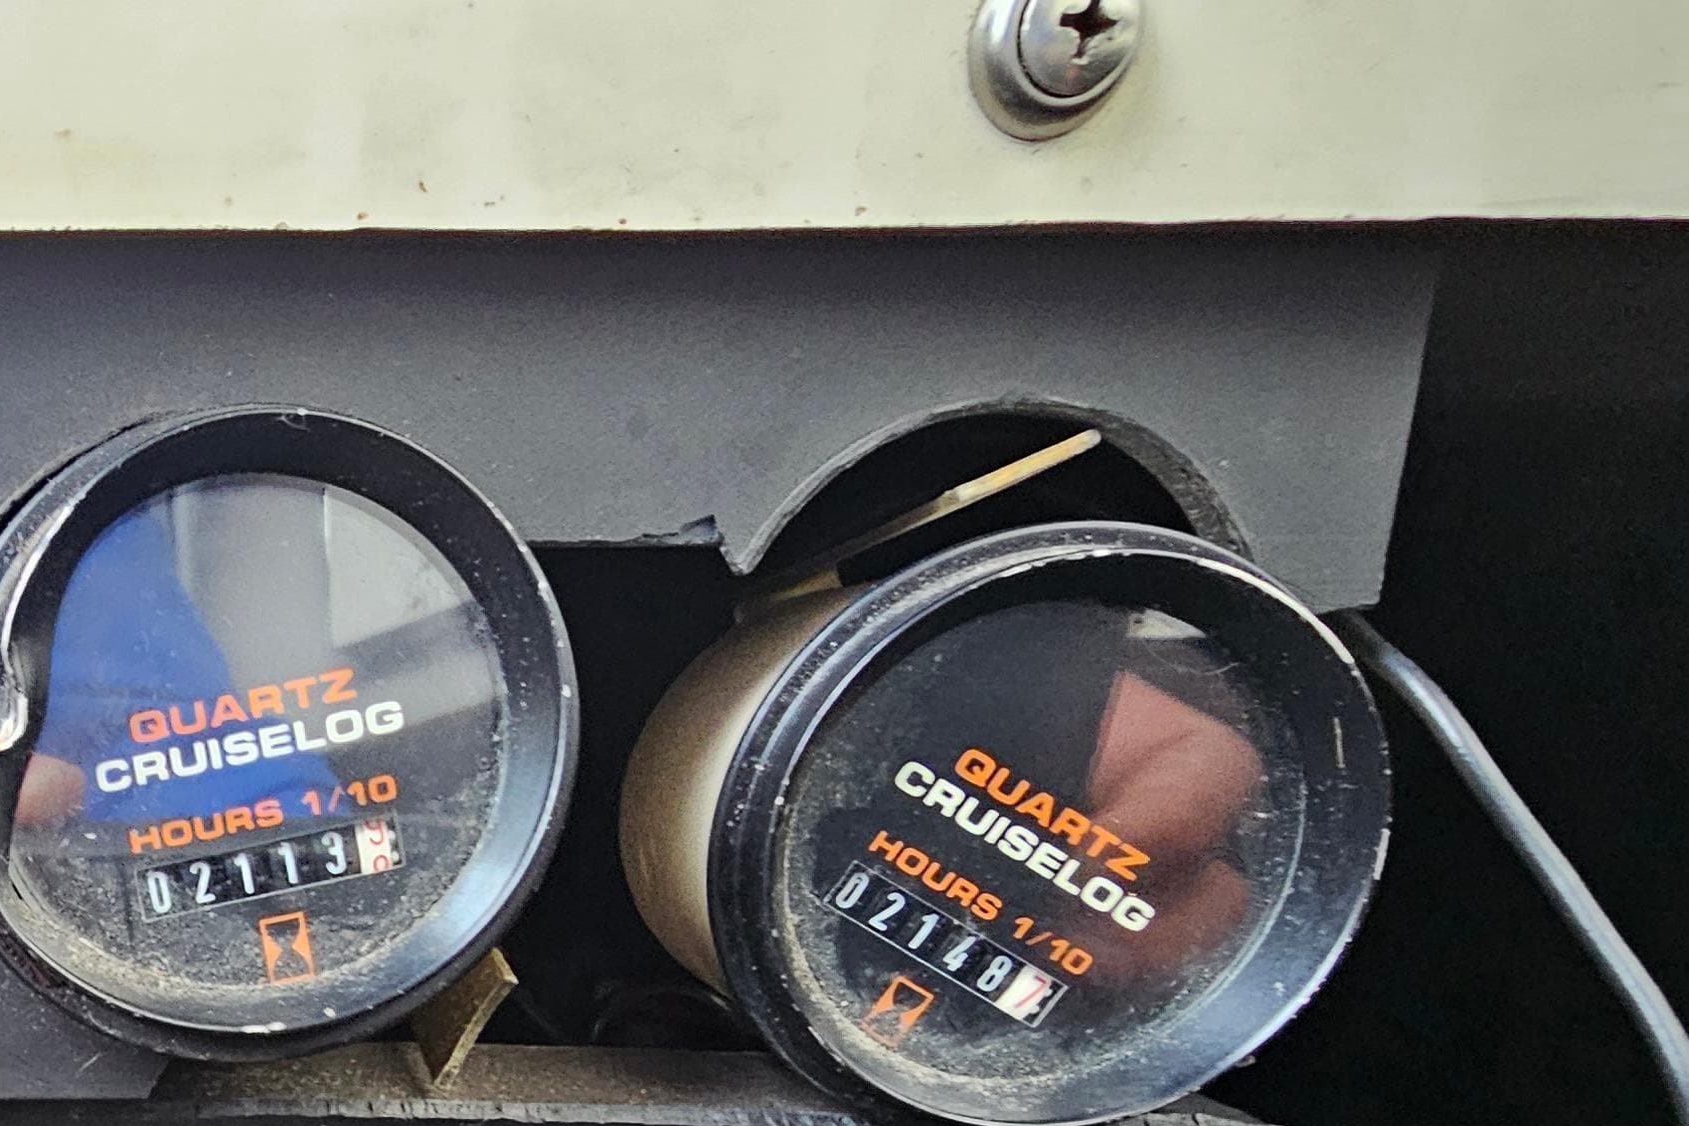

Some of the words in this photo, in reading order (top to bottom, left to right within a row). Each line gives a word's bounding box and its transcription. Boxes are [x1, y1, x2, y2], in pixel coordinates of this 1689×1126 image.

[95, 700, 405, 793] CRUISELOG
[129, 667, 358, 744] QUARTZ
[128, 798, 284, 855] HOURS
[301, 774, 398, 817] 1/10
[894, 760, 1156, 932] CRUISELOG
[954, 748, 1151, 882] QUARTZ
[835, 872, 1048, 1009] 021487
[868, 830, 1003, 921] HOURS
[1012, 916, 1094, 976] 1/10
